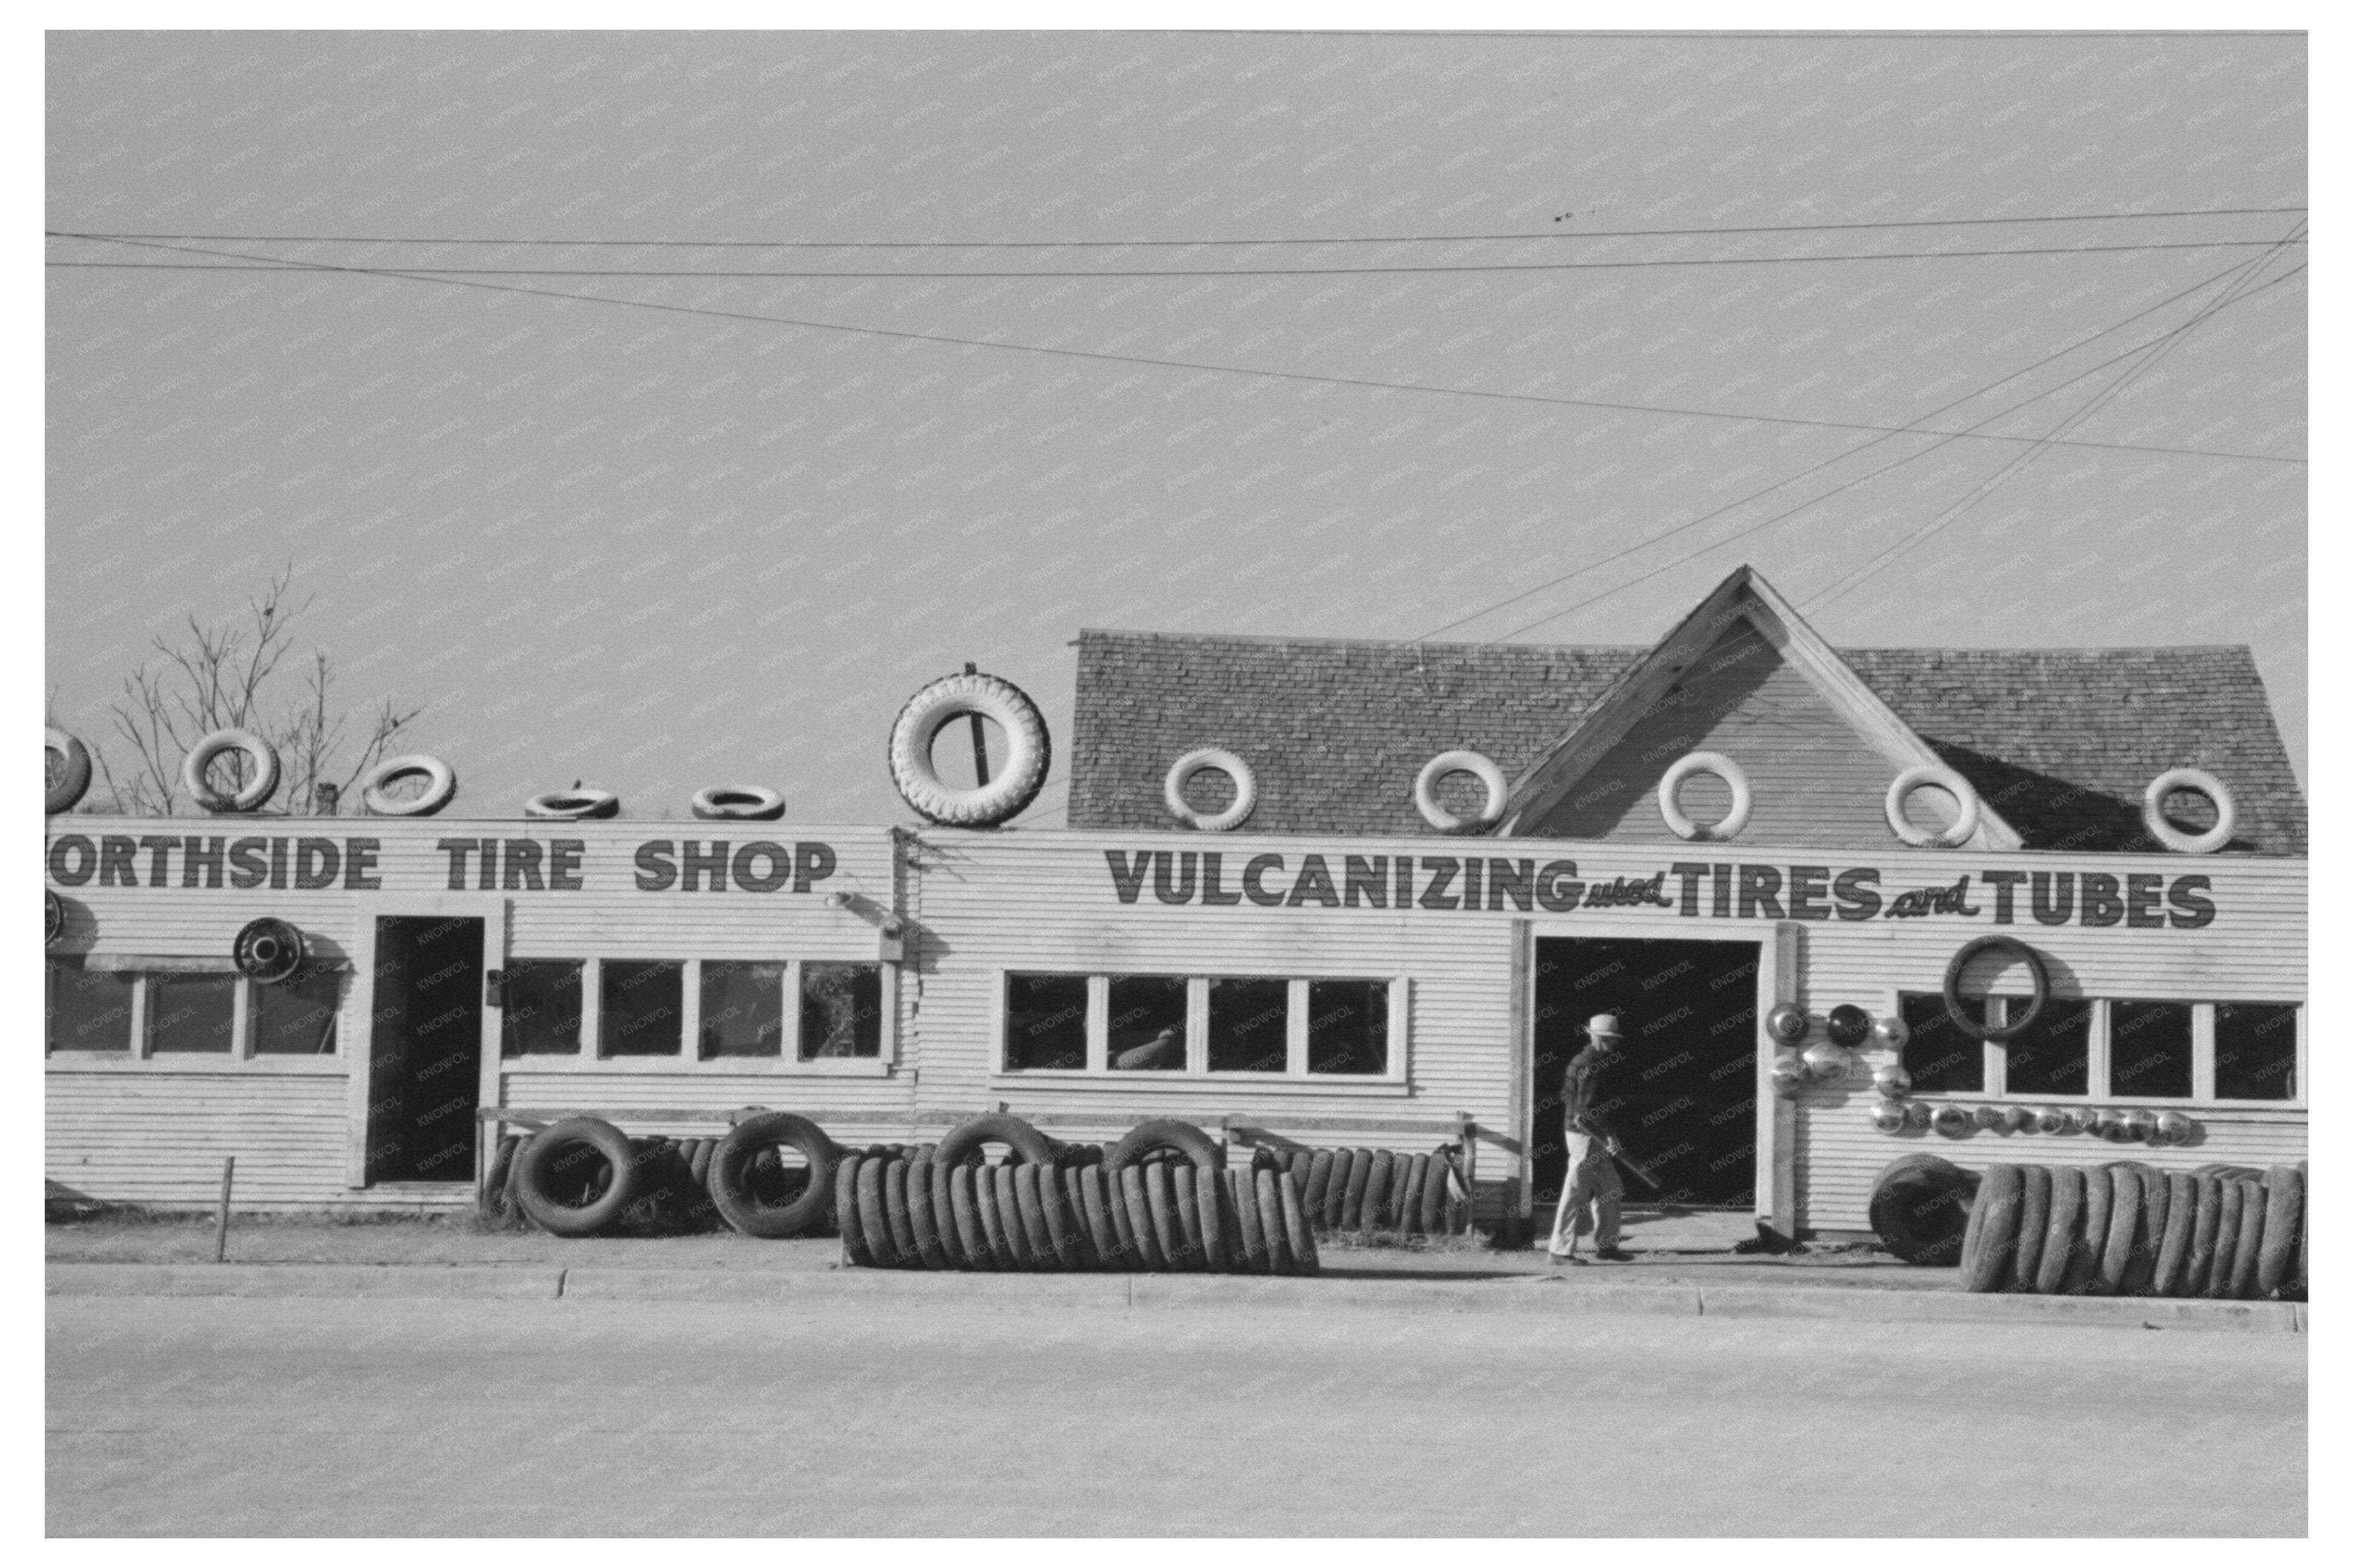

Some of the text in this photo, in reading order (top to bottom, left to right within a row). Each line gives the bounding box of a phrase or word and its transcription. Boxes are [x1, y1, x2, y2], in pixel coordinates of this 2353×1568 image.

[45, 834, 836, 892] ORTHSIDE TIRE SHOP
[1104, 850, 2216, 928] VULCANIZING used TIRES and TUBES
